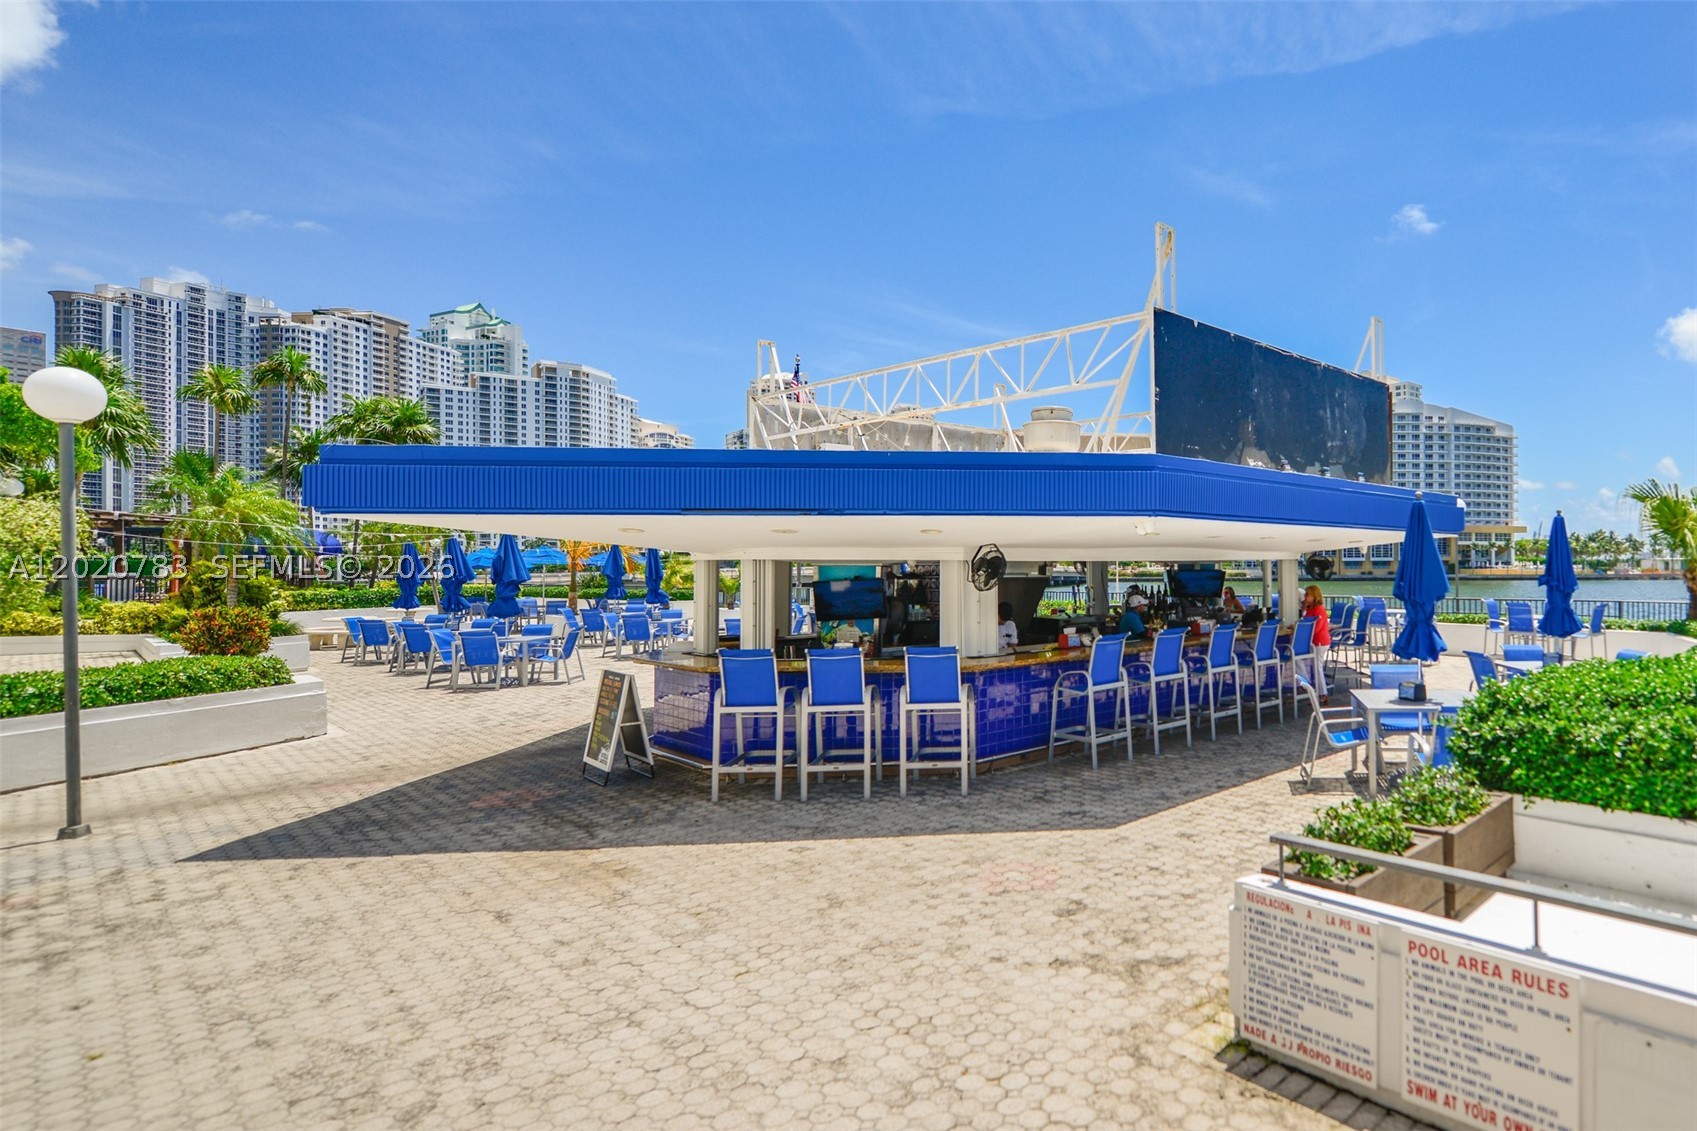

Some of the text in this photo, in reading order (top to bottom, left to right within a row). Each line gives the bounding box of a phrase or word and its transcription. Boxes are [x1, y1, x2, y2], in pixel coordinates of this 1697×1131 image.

[1408, 940, 1569, 999] POOL AREA RULES
[1243, 1023, 1266, 1040] NADE
[1271, 1034, 1277, 1044] A
[1336, 1059, 1372, 1082] RIESGO
[1407, 1080, 1437, 1102] SWIM
[1444, 1094, 1458, 1111] AT
[1464, 1102, 1498, 1126] YOUR
